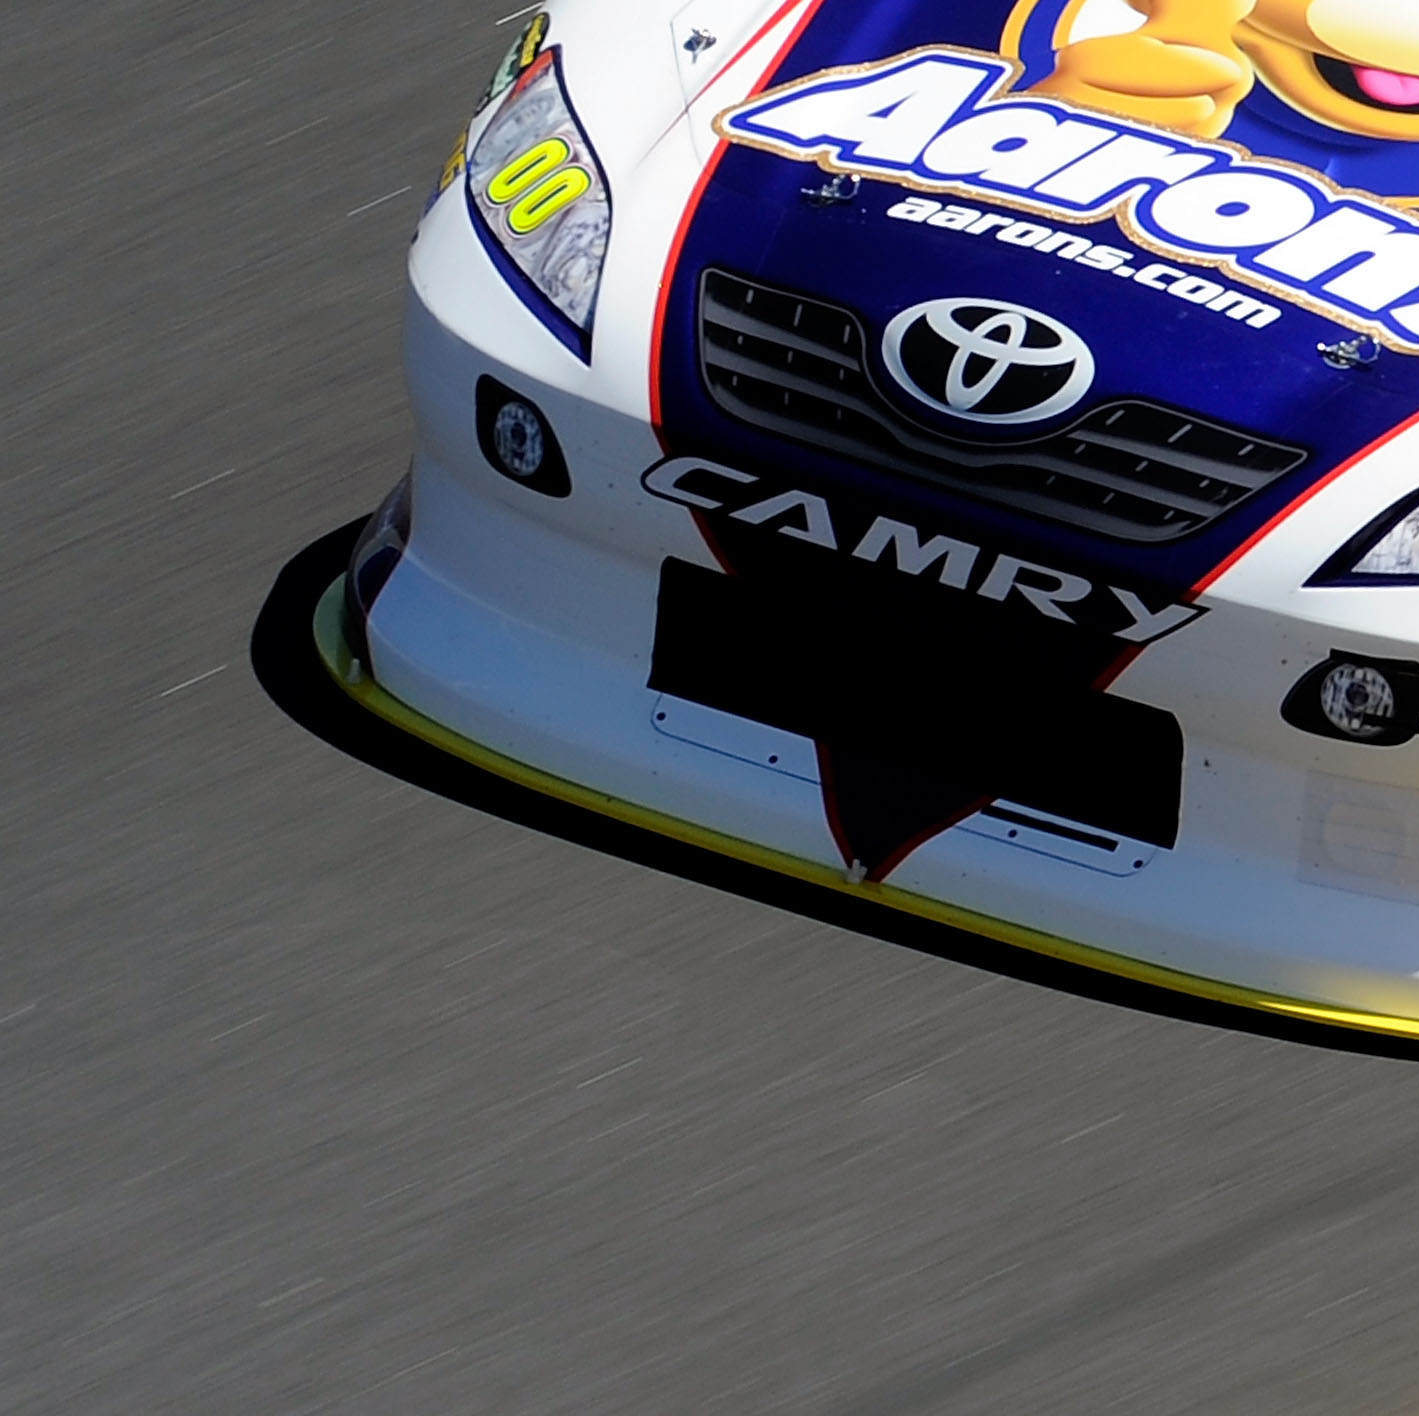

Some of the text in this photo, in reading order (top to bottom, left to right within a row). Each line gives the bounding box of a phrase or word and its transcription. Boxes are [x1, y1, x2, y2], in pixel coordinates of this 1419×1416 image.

[483, 135, 594, 236] 00
[886, 196, 1282, 330] aarons.com
[646, 456, 1201, 640] CAMRY
